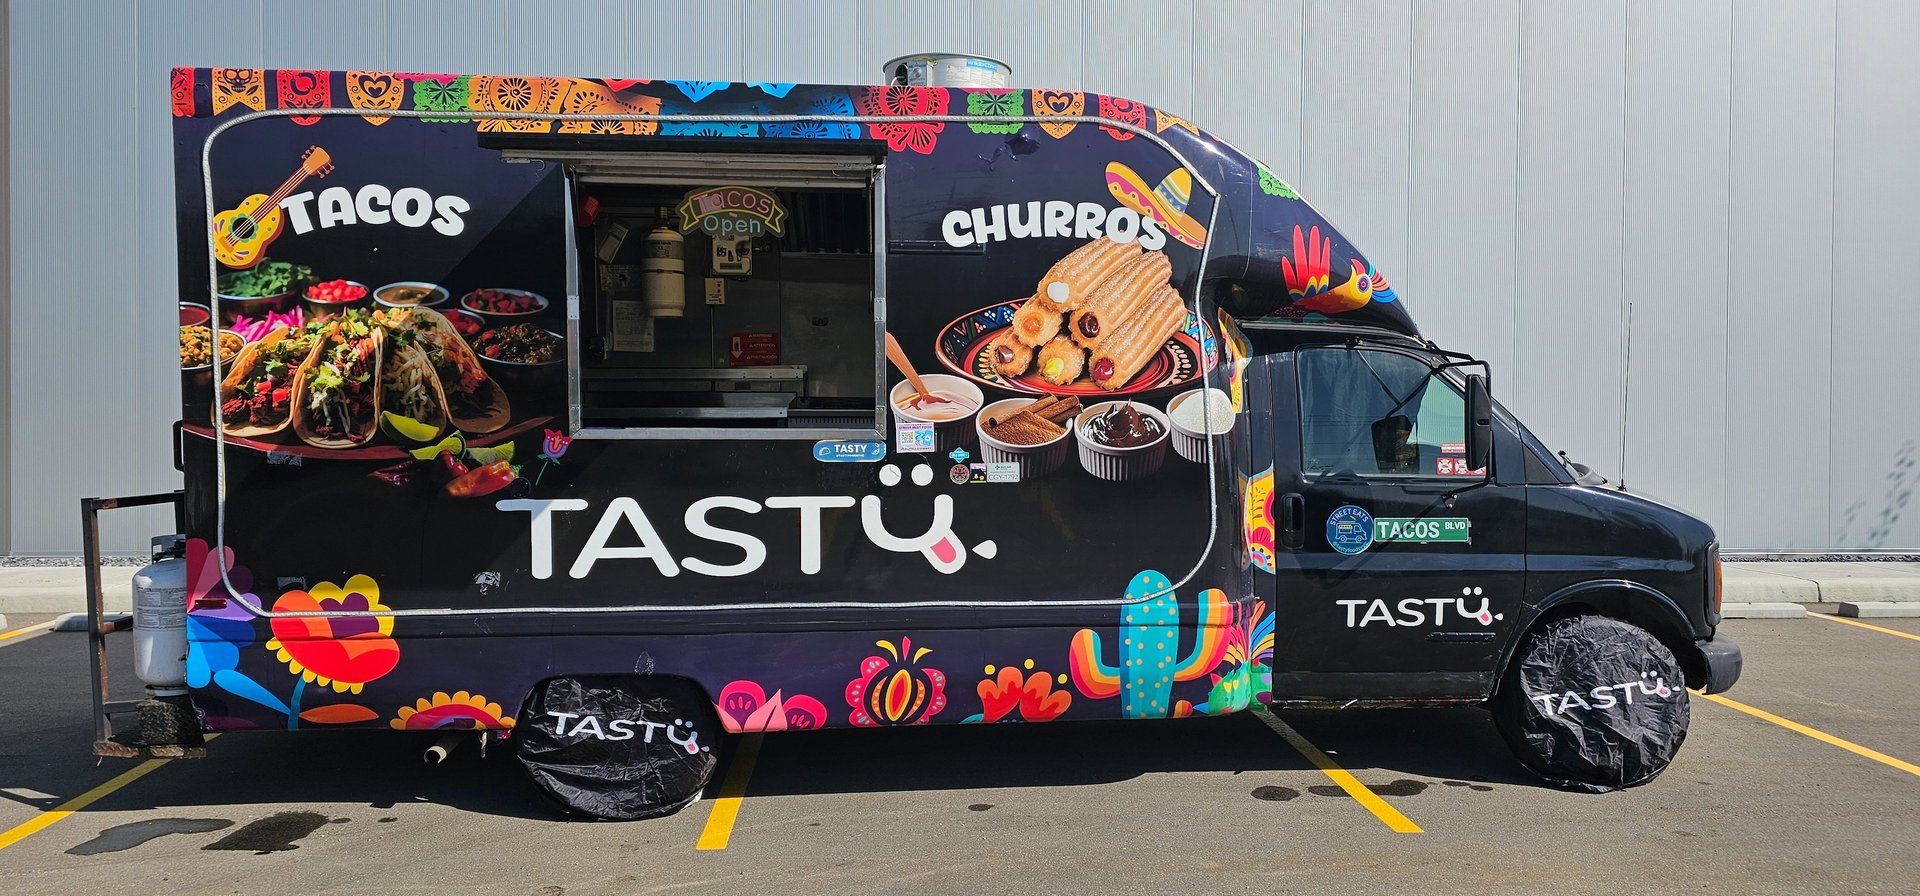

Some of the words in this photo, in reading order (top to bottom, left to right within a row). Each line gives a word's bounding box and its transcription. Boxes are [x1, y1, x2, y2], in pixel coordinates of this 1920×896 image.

[279, 185, 471, 236] TACOS
[693, 190, 772, 214] Tacos
[703, 215, 762, 236] Open
[942, 200, 1167, 251] CHURROS
[834, 444, 867, 453] TASTY
[1329, 508, 1352, 526] STREET
[1352, 508, 1369, 523] EATS
[1377, 521, 1440, 539] TACOS
[1445, 521, 1466, 530] BLVD
